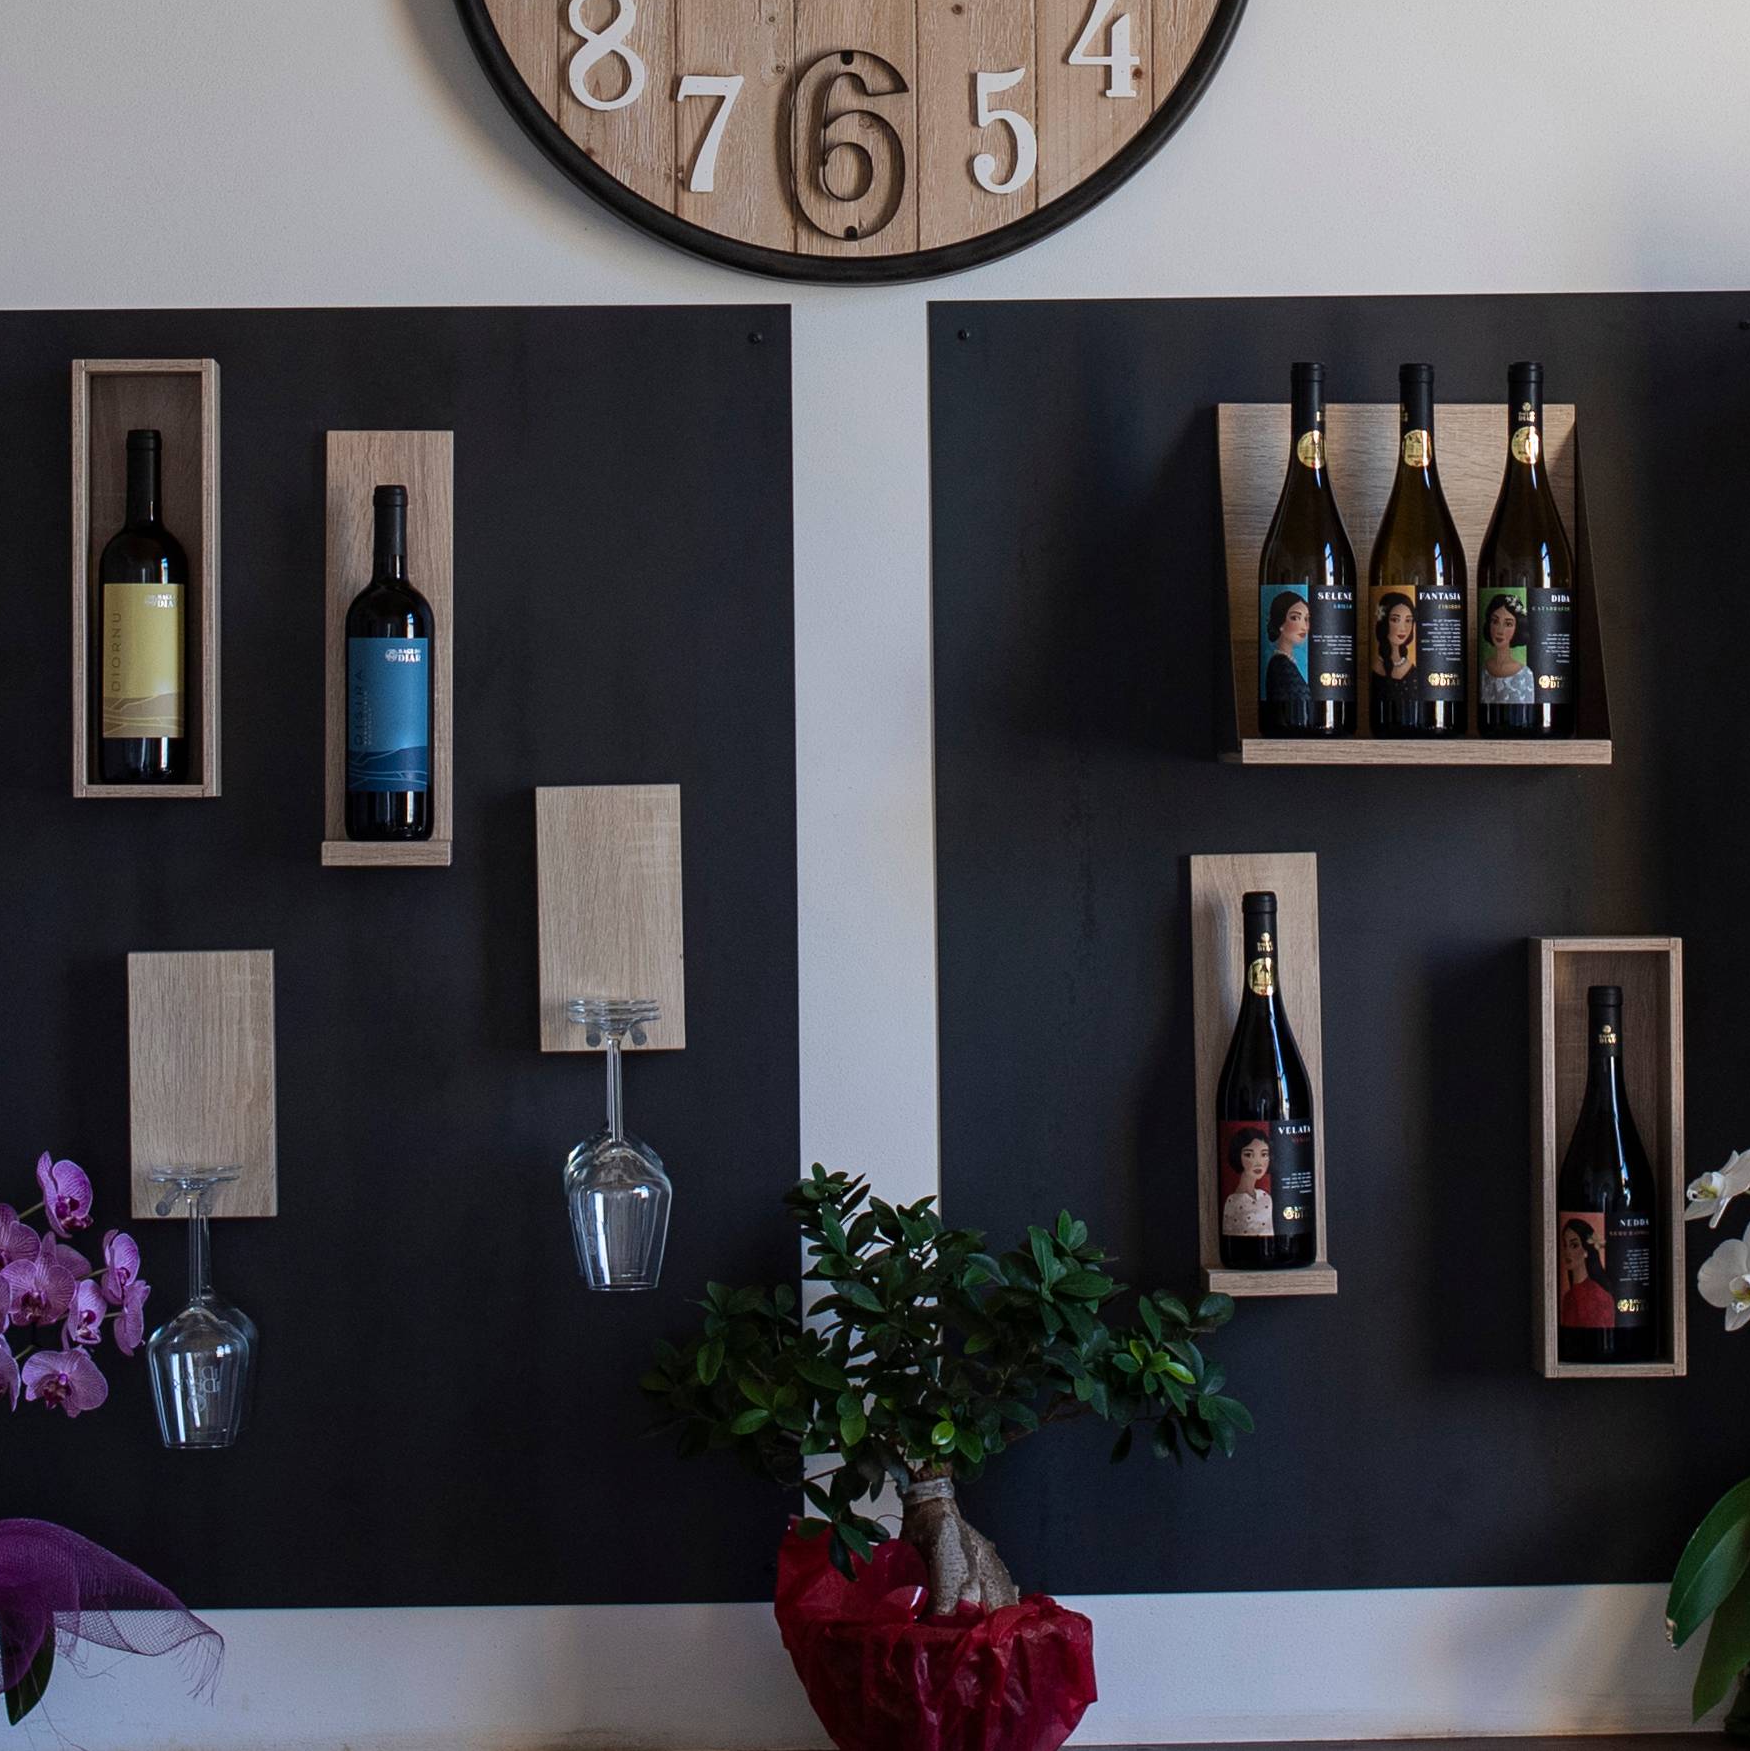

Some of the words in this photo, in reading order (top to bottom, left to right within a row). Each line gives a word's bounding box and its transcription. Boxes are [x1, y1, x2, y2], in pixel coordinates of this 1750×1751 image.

[676, 75, 744, 192] 7
[789, 50, 909, 239] 6
[973, 68, 1038, 193] 5
[111, 613, 121, 692] DIORNU
[1419, 592, 1461, 601] FANTASIA
